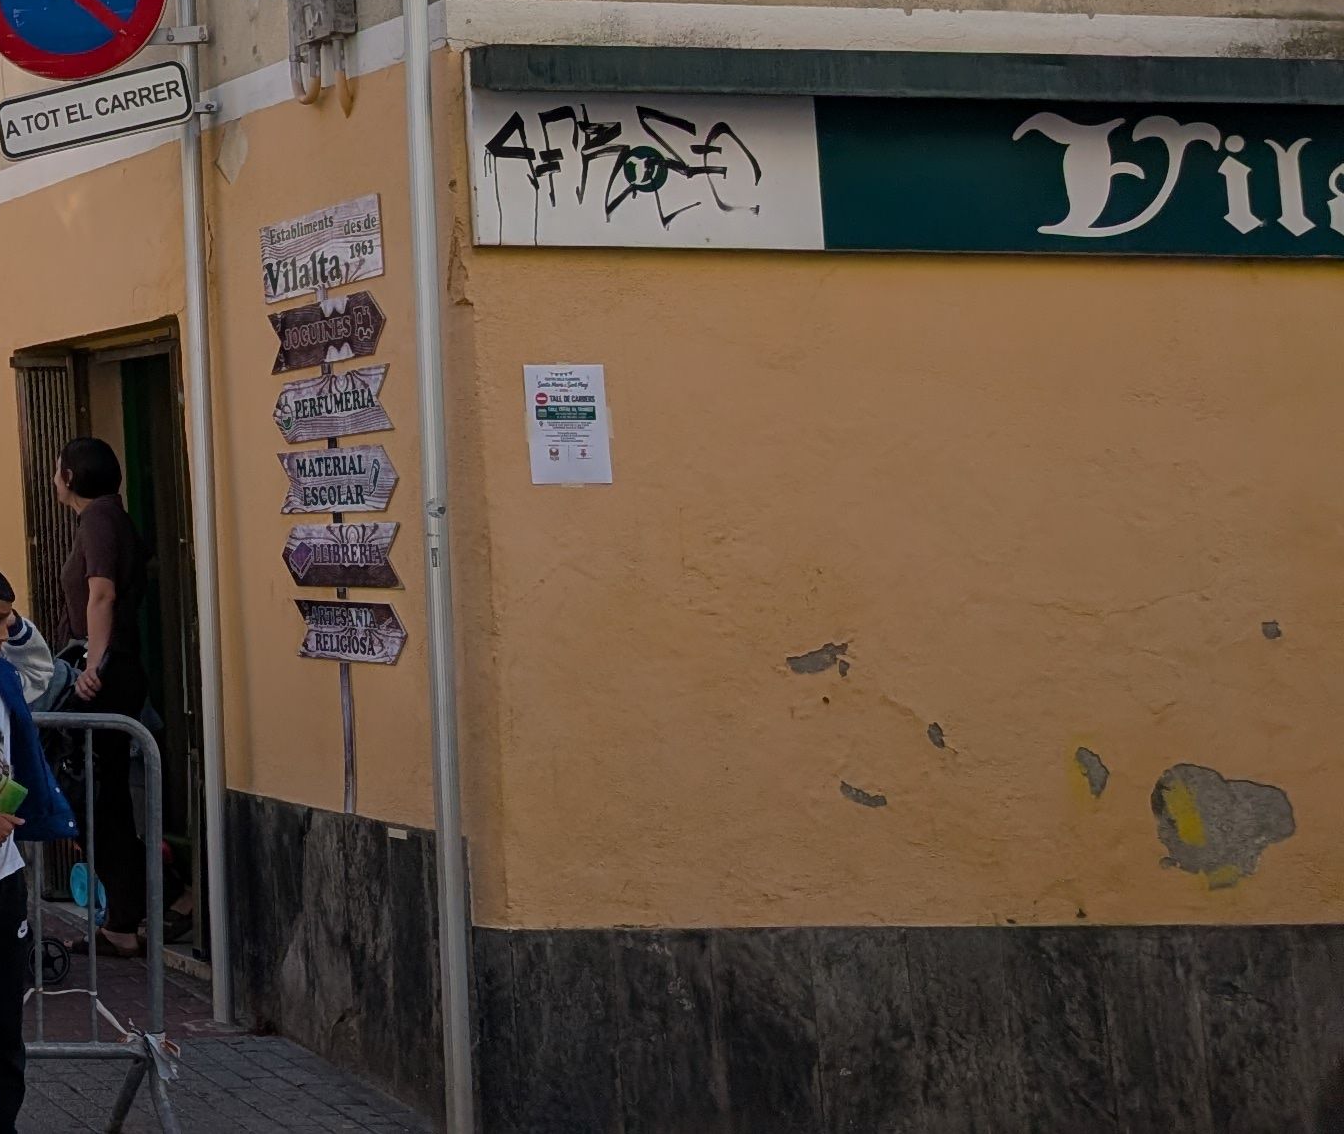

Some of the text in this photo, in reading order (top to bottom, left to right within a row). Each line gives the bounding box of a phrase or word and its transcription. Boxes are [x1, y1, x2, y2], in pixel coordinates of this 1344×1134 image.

[5, 79, 183, 139] A TOT EL CARRER
[1012, 111, 1344, 237] Vil
[269, 213, 377, 246] Establiments des de
[349, 239, 374, 259] 1963
[264, 250, 342, 296] Vilalta
[283, 316, 352, 351] JOGUINES
[293, 387, 376, 420] PERFUMERIA
[295, 454, 366, 478] MATERIAL
[302, 484, 366, 507] ESCOLAR
[312, 543, 384, 564] LLIBRERIA
[315, 633, 376, 656] RELIGIOSA
